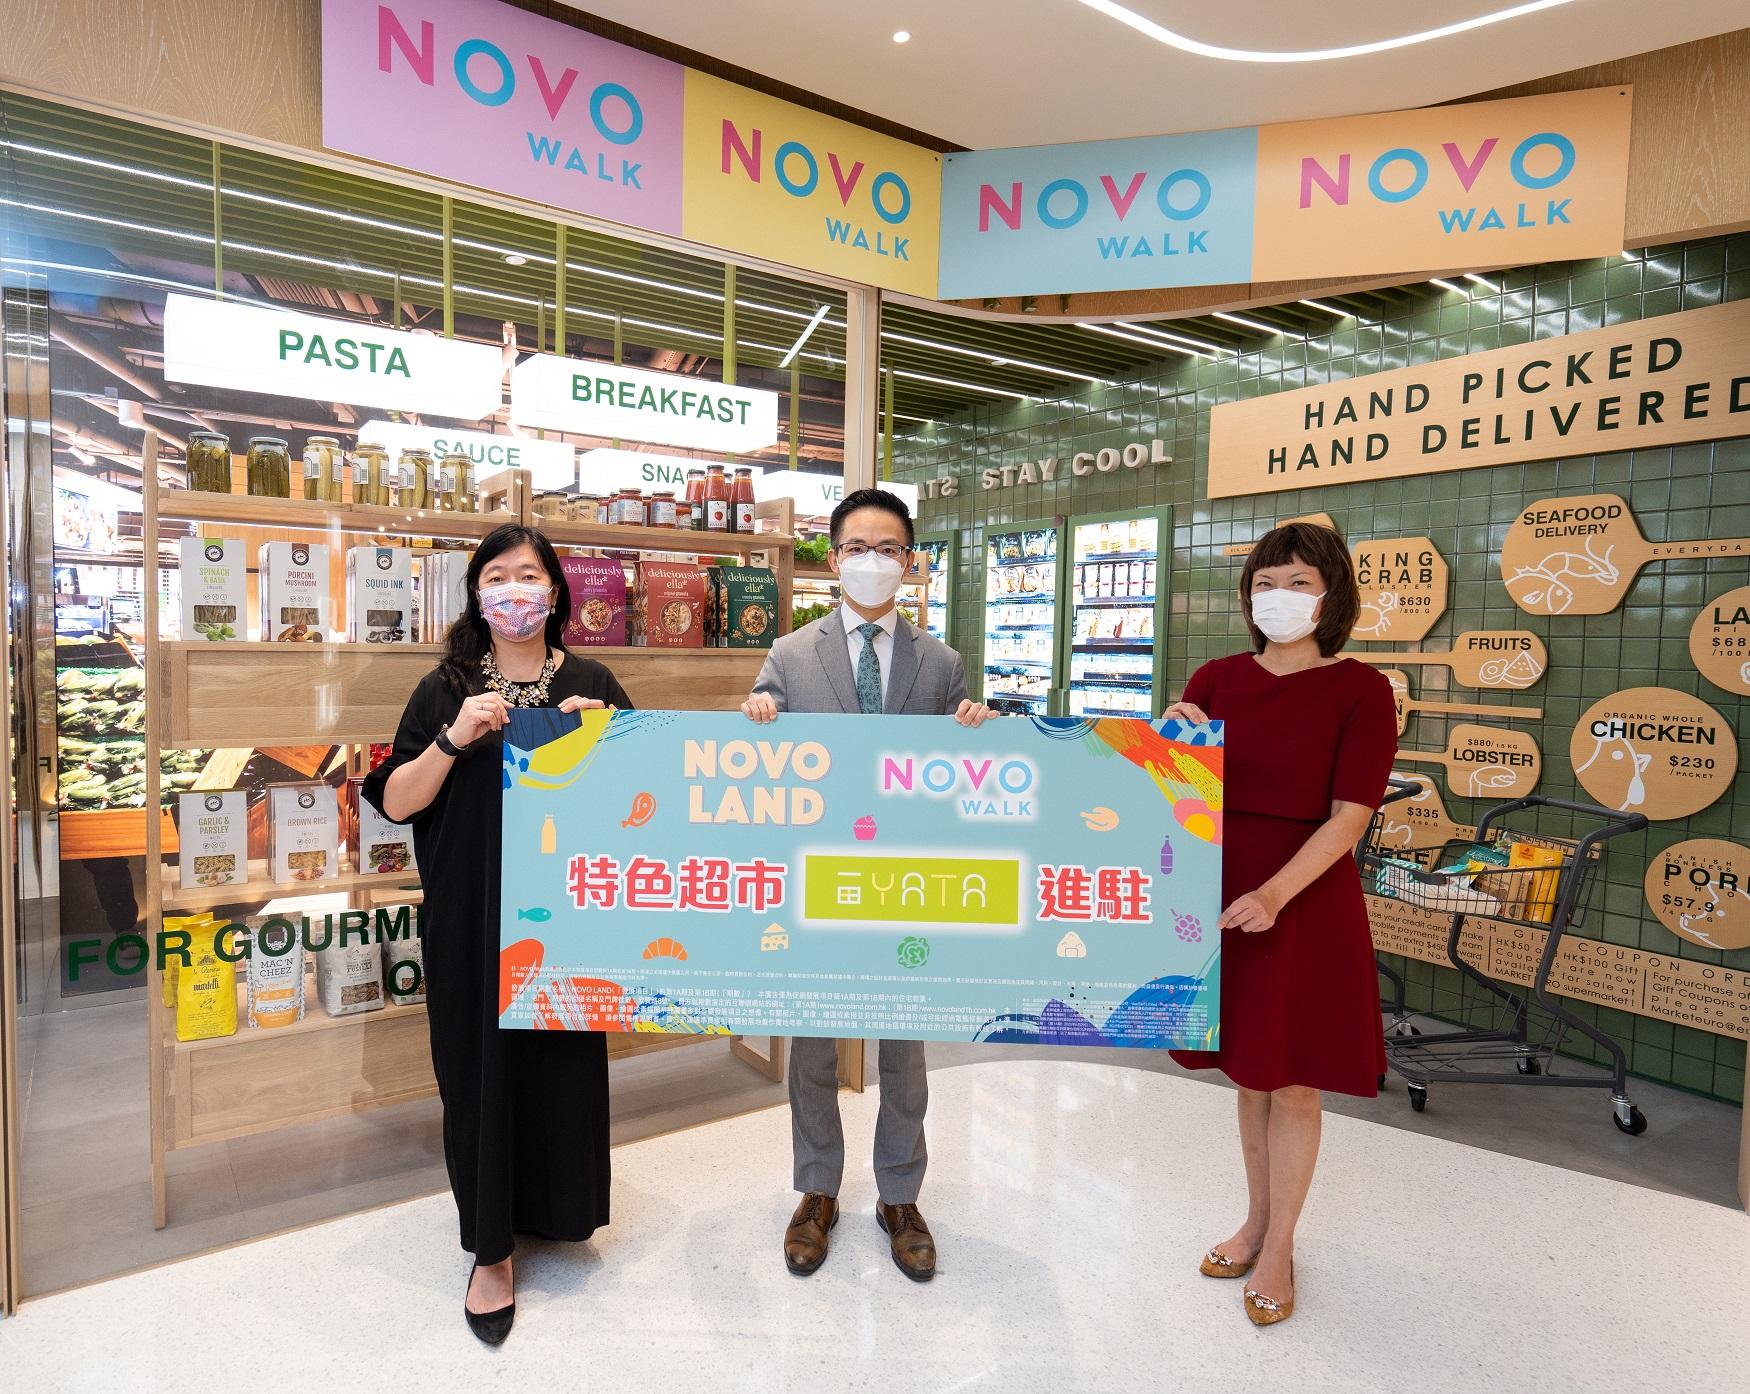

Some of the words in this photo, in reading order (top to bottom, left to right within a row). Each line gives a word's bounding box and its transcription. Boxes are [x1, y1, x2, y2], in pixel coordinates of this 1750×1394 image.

[377, 5, 643, 145] NOVO
[526, 132, 642, 189] WALK
[1300, 133, 1576, 209] NOVO
[721, 119, 911, 224] NOVO
[979, 169, 1211, 232] NOVO
[1438, 199, 1573, 234] WALK
[826, 217, 910, 261] WALK
[1098, 230, 1209, 259] WALK
[279, 330, 411, 378] PASTA
[1304, 383, 1430, 430] HAND
[1462, 337, 1683, 404] PICKED
[571, 374, 751, 426] BREAKFAST
[1267, 433, 1389, 474] HAND
[982, 458, 1058, 490] STAY
[1072, 439, 1172, 477] COOL
[1523, 505, 1622, 525] SEAFOOD
[1535, 523, 1608, 538] DELIVERY
[1359, 551, 1433, 568] KING
[1653, 544, 1750, 555] EVERYDA
[199, 567, 230, 577] SPINACH
[287, 570, 315, 580] PORCINI
[564, 564, 622, 577] deliciously
[648, 568, 700, 581] deliciously
[728, 572, 775, 586] deliciously
[1358, 569, 1433, 584] CRAB
[285, 579, 317, 587] MUSHROOM
[365, 578, 389, 589] SQUID
[390, 579, 404, 590] INK
[1400, 597, 1431, 606] $630
[1468, 637, 1532, 650] FRUITS
[1603, 712, 1656, 721] ORGANIC
[1663, 715, 1704, 723] WHOLE
[1590, 720, 1715, 745] CHICKEN
[683, 739, 832, 781] NOVO
[1453, 748, 1533, 767] LOBSTER
[1669, 755, 1715, 769] $230
[884, 758, 1033, 794] NOVO
[689, 785, 826, 826] LAND
[962, 800, 1032, 816] WALK
[1407, 807, 1439, 819] $335
[198, 817, 222, 826] GARLIC
[224, 816, 230, 825] &
[199, 826, 229, 835] PARSLEY
[287, 818, 312, 827] BROWN
[313, 816, 328, 825] RICE
[1665, 852, 1732, 866] DANISH
[1665, 858, 1732, 872] BONELESS
[568, 855, 787, 912] 特色超市
[871, 872, 986, 908] YATA
[1038, 866, 1151, 922] 進駐
[1662, 894, 1714, 912] $57.9
[1384, 914, 1400, 922] your
[1402, 916, 1425, 928] credit
[1427, 923, 1446, 933] card
[1381, 930, 1389, 939] to
[1391, 933, 1402, 942] an
[1403, 936, 1424, 947] extra
[1427, 941, 1446, 952] $450
[1398, 925, 1440, 941] payments
[1462, 941, 1483, 950] earn
[68, 930, 193, 983] FOR
[1375, 939, 1391, 948] ash
[1413, 946, 1423, 955] 19
[1427, 950, 1447, 961] Nov
[1496, 938, 1530, 952] HK$50
[1563, 952, 1608, 968] HK$100
[1614, 963, 1639, 975] Gift
[1514, 929, 1547, 943] GIF
[1578, 943, 1680, 971] COUPON
[259, 967, 293, 978] CHEEZ
[261, 960, 283, 969] MAC
[1495, 967, 1531, 981] MARKET
[1570, 965, 1595, 975] are
[1605, 973, 1637, 985] now
[1562, 972, 1580, 982] for
[1587, 978, 1614, 991] sale
[1621, 986, 1635, 995] at
[1653, 972, 1671, 982] For
[1675, 978, 1734, 996] purchase
[1651, 995, 1724, 1017] please
[1653, 983, 1674, 994] Gift
[1678, 989, 1735, 1009] Coupons
